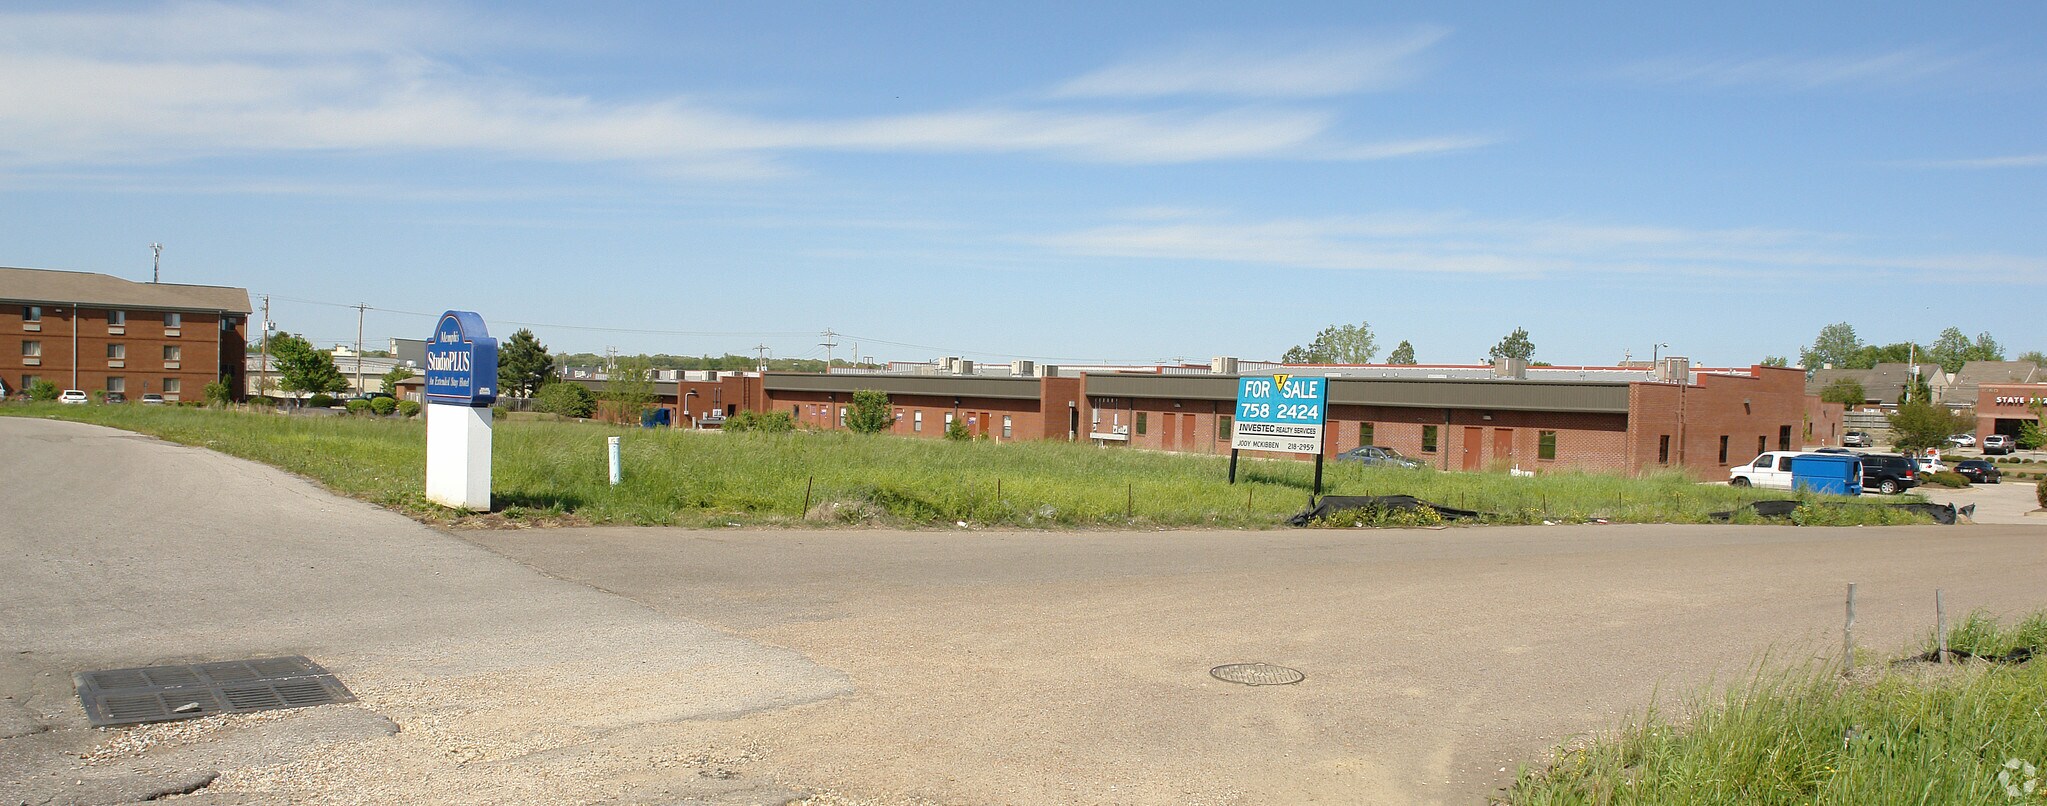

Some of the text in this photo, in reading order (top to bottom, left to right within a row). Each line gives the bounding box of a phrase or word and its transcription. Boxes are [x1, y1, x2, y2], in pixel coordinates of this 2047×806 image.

[441, 331, 460, 345] Memphis
[427, 351, 470, 372] StudioPLUS
[435, 376, 450, 386] Extended
[450, 377, 458, 388] Stay
[459, 377, 470, 387] Hotel
[1244, 380, 1318, 399] FOR SALE
[1996, 396, 2025, 404] STATE
[1241, 403, 1319, 420] 758 2424
[1239, 424, 1274, 432] INVESTEC
[1293, 427, 1316, 435] SERVICES
[1252, 441, 1280, 449] MCKIBBEN
[1287, 442, 1315, 451] 218-2959
